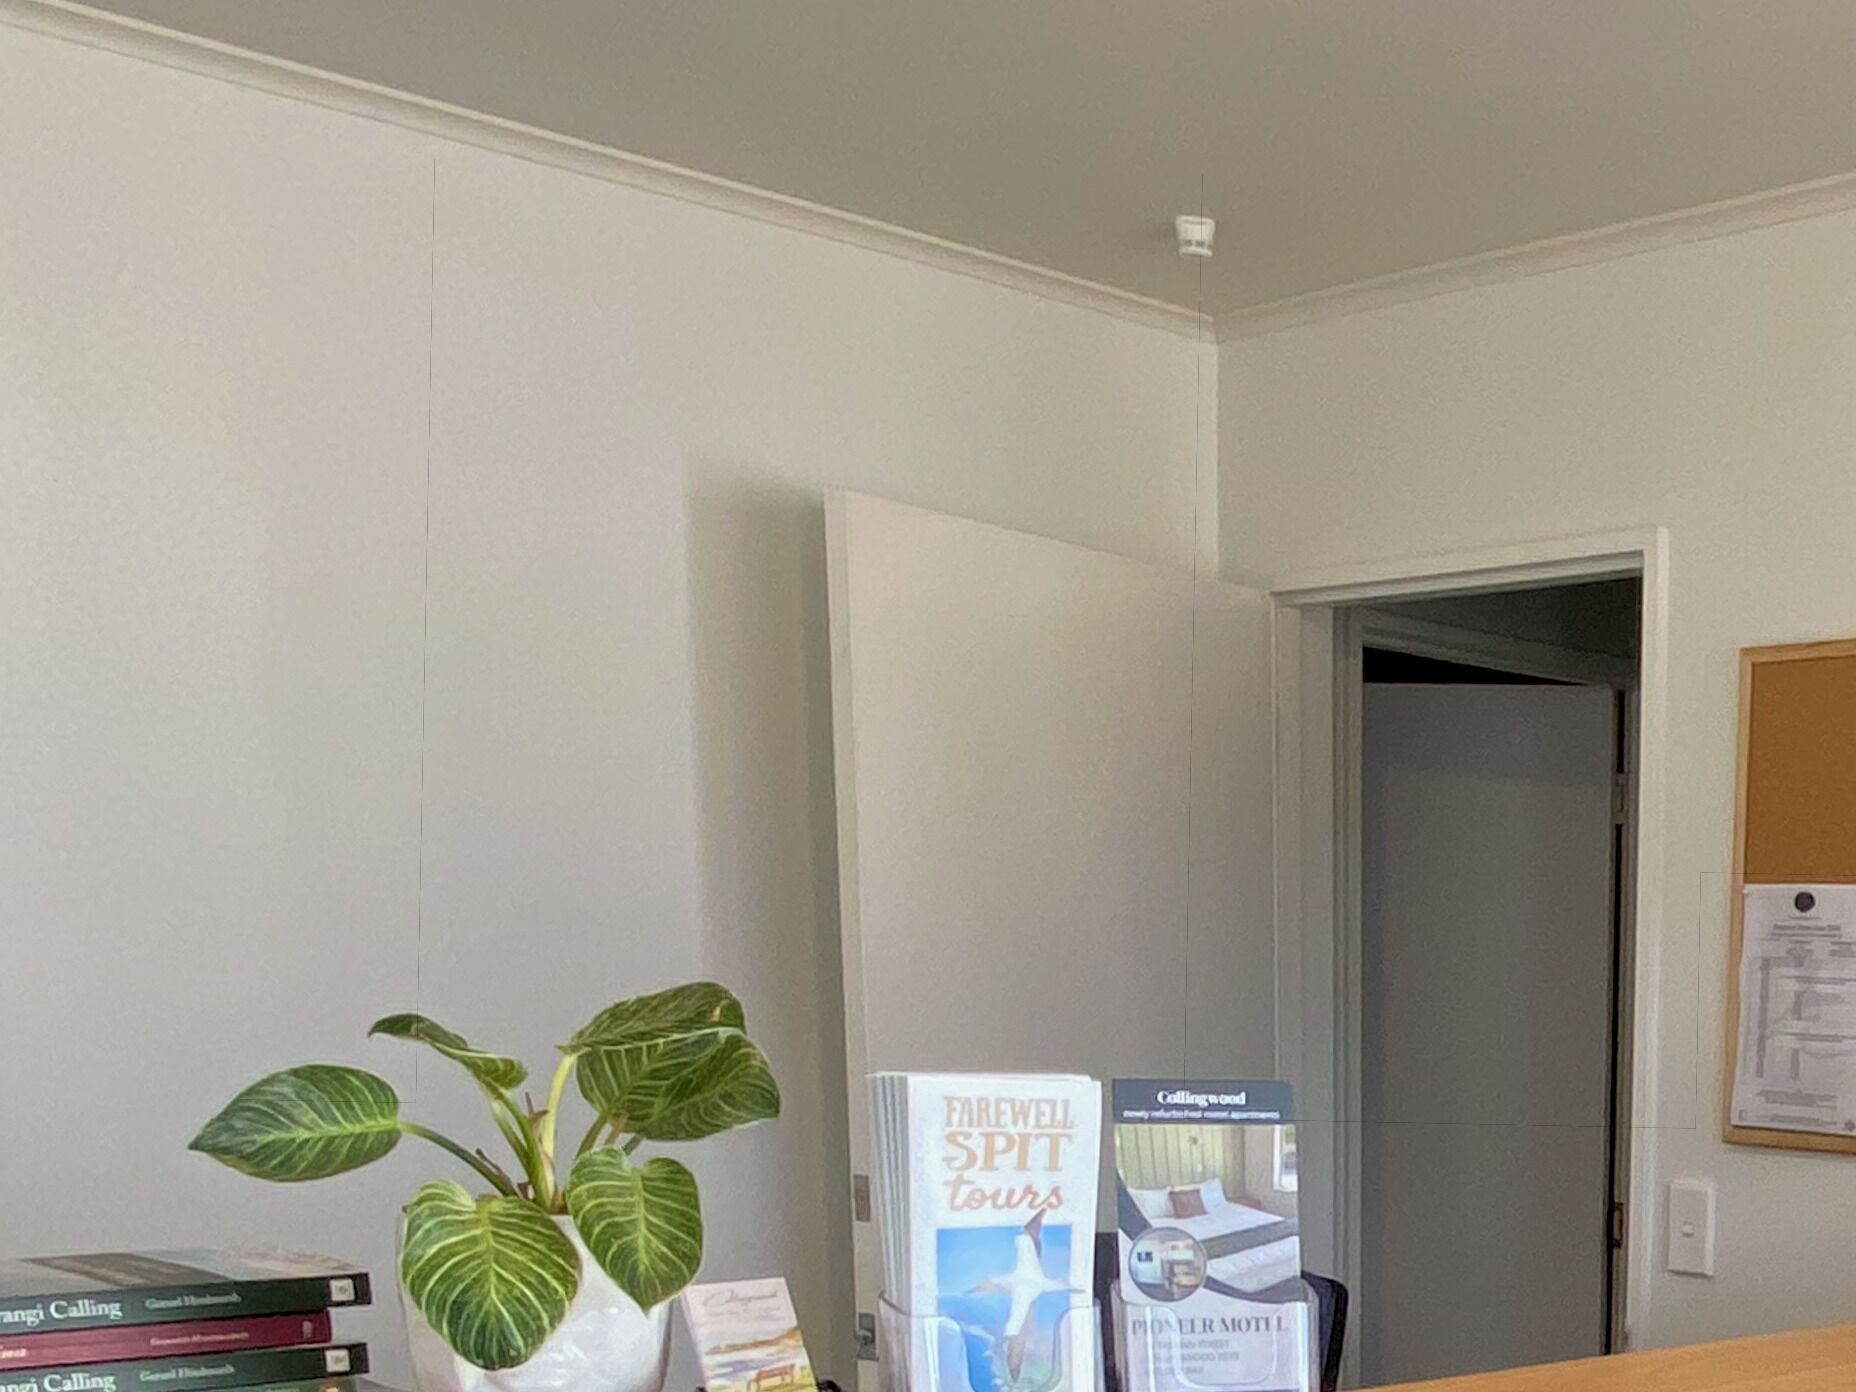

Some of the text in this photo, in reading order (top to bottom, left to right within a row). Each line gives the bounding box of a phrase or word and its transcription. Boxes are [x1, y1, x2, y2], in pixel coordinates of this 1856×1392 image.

[1157, 1090, 1246, 1107] Collingwood
[943, 1096, 1075, 1129] FAREWELL
[942, 1131, 1073, 1172] SPIT
[943, 1173, 1063, 1211] tours
[50, 1299, 123, 1320] Calling
[43, 1372, 117, 1392] Calling
